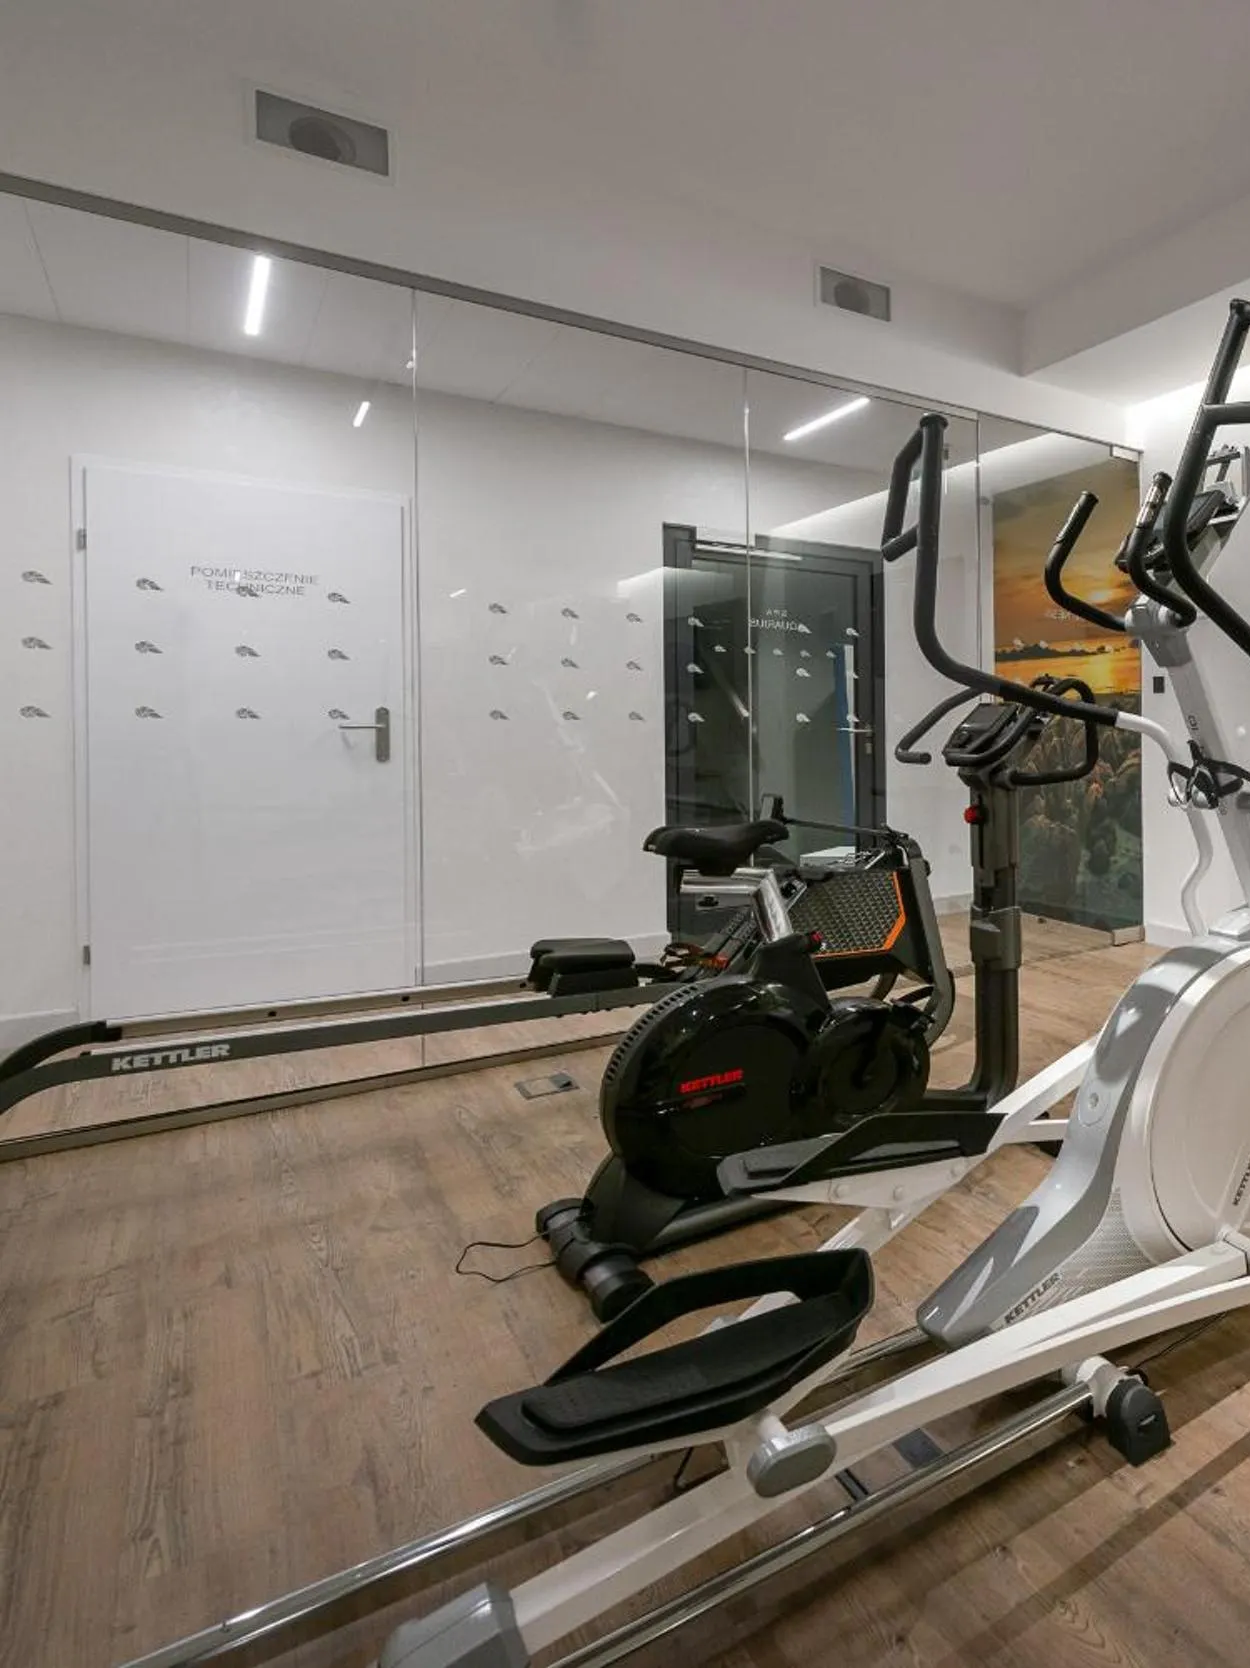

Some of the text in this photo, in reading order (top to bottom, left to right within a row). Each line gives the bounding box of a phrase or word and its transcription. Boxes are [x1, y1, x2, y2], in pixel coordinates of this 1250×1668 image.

[207, 580, 305, 596] TECNICZNE
[111, 1043, 231, 1072] KETTLER
[679, 1068, 744, 1094] KETTLER
[1004, 1272, 1061, 1324] KETTLER
